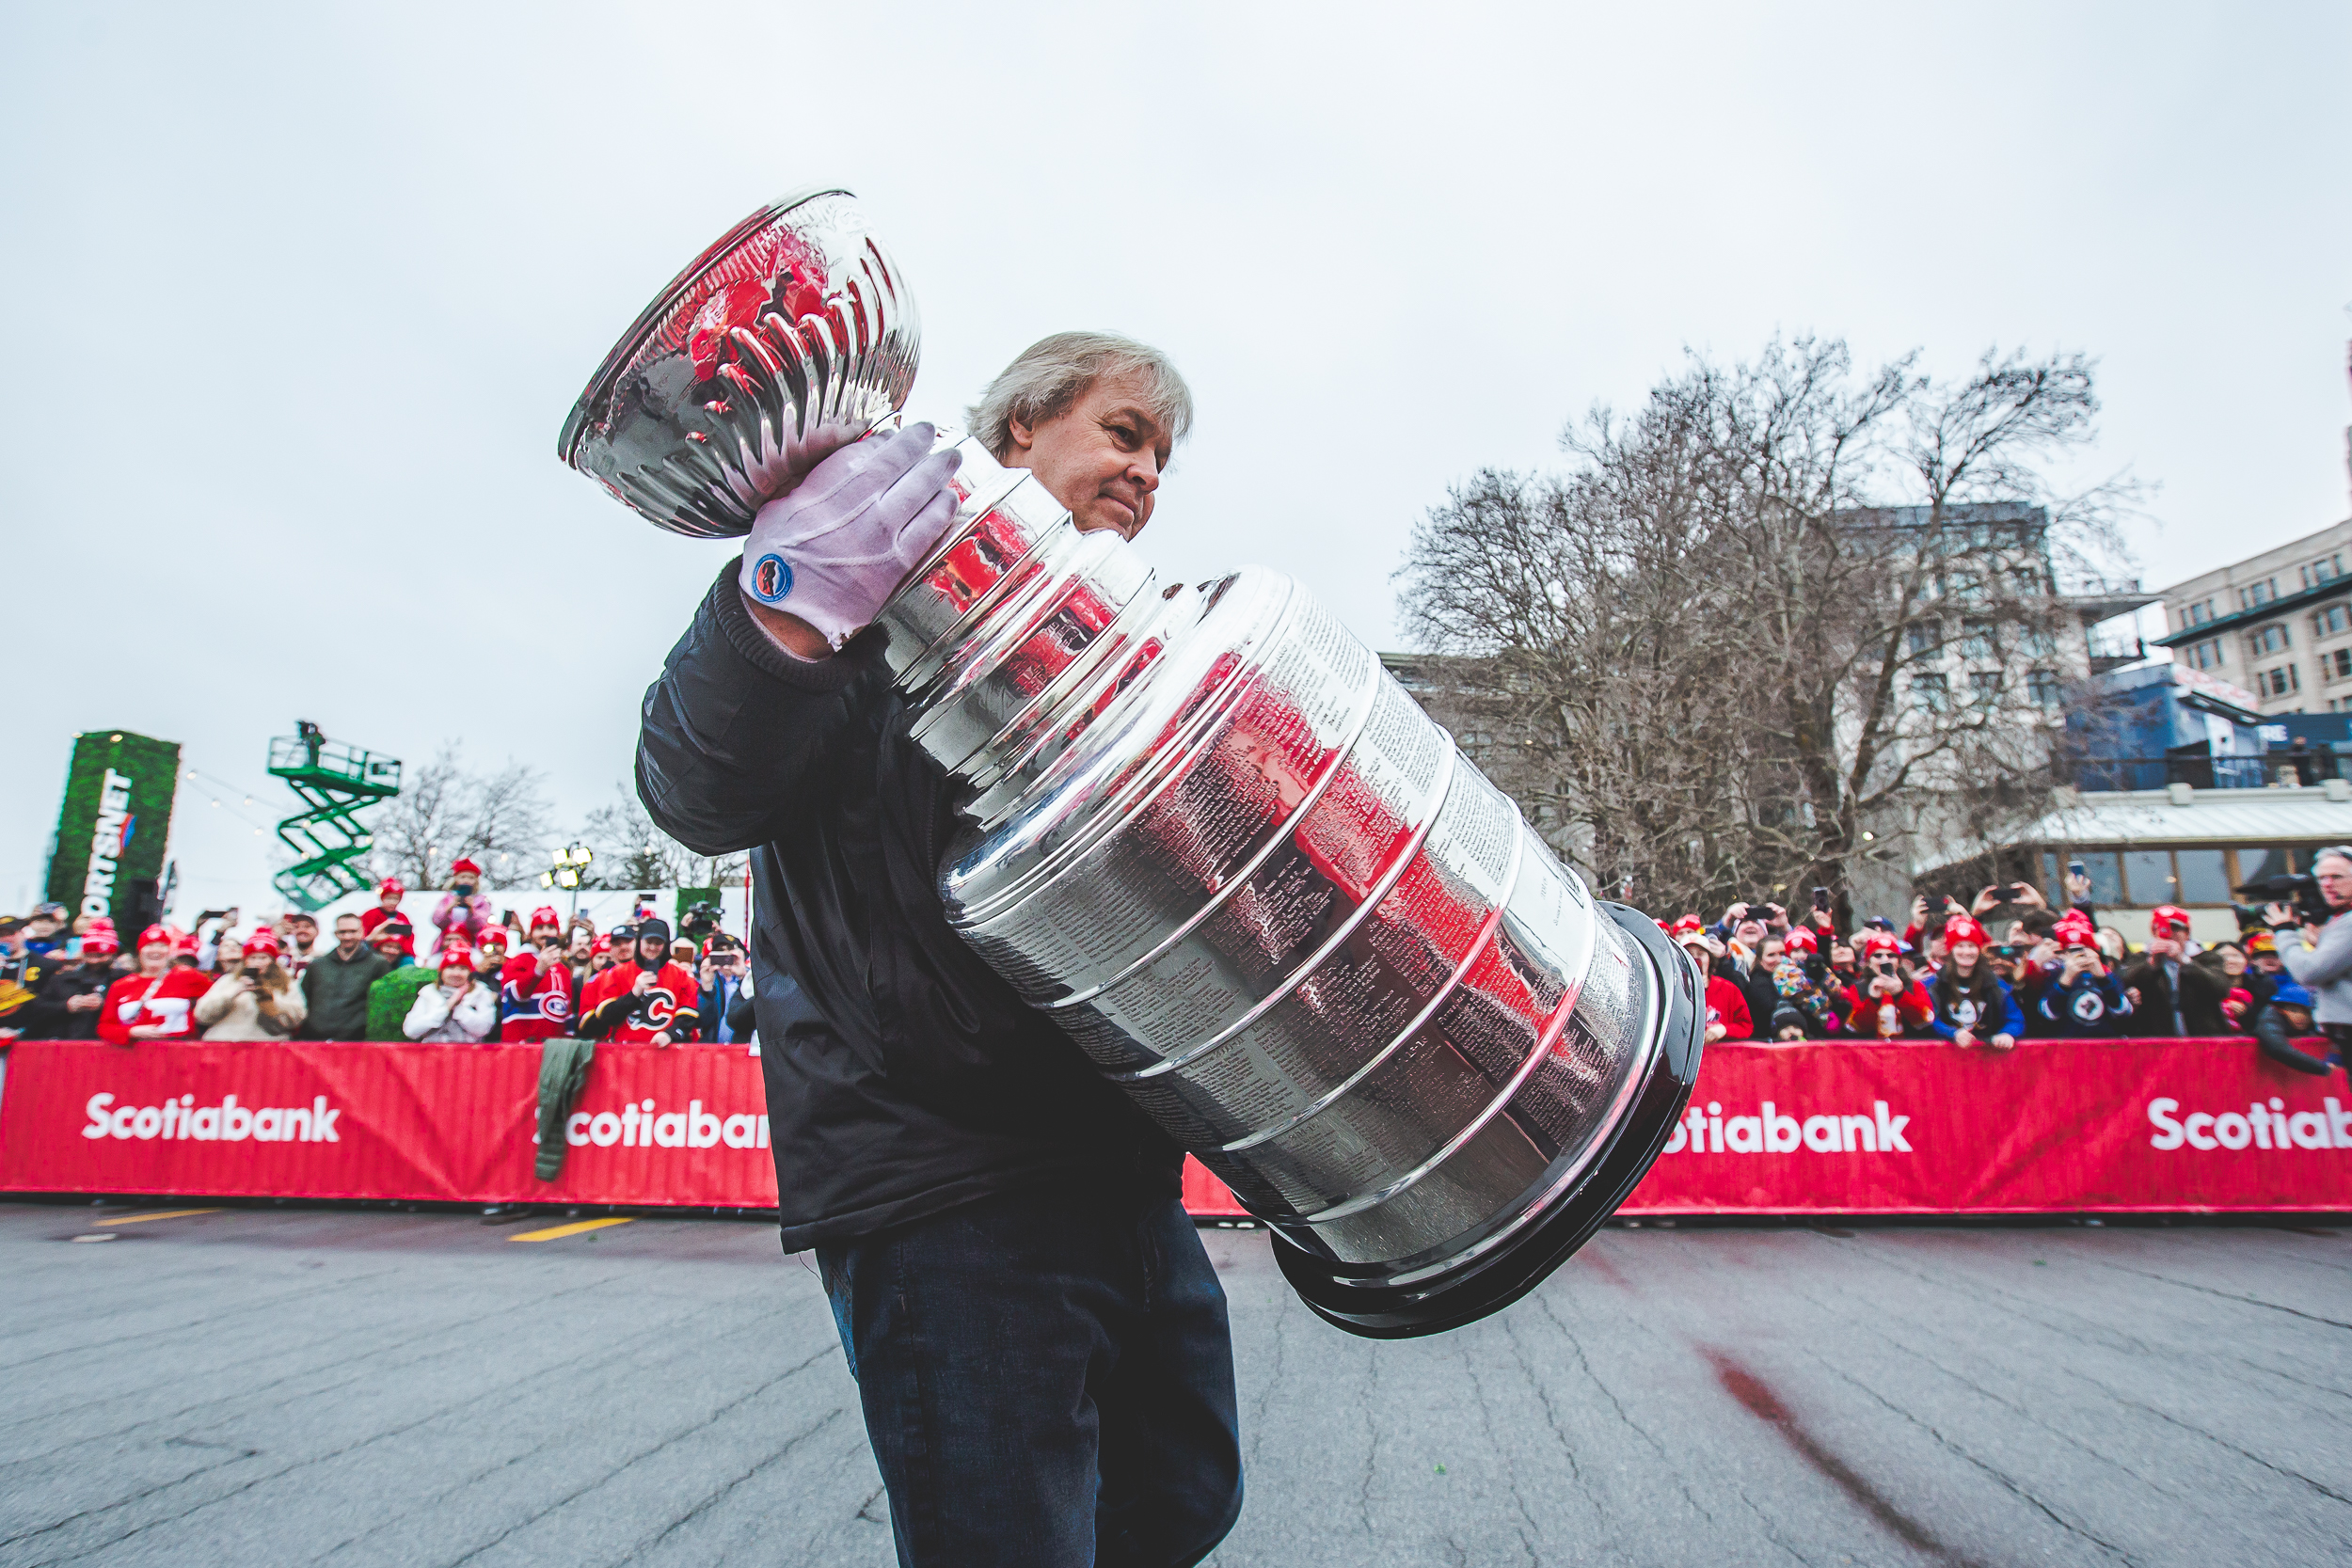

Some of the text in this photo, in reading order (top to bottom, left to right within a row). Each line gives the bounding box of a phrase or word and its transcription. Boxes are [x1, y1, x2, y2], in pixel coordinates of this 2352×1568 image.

[82, 1092, 341, 1143] Scotiabank
[532, 1098, 770, 1148] cotiaba
[2147, 1097, 2352, 1150] Scotiab
